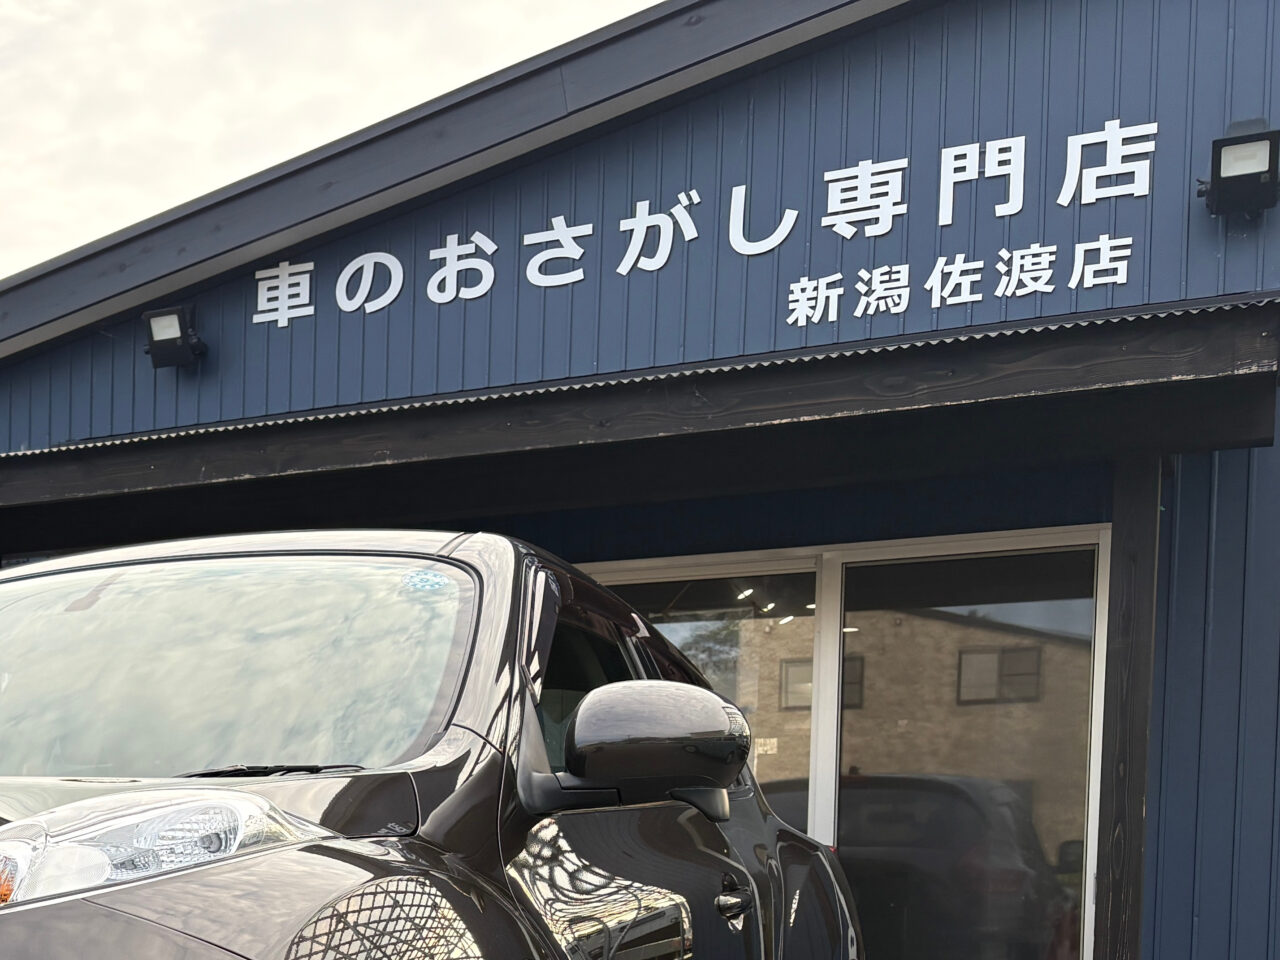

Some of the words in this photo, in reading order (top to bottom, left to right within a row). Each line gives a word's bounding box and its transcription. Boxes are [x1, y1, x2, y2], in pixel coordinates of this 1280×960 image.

[252, 119, 1158, 328] 車のおさがし専門店
[785, 234, 1133, 327] 新潟佐渡店
